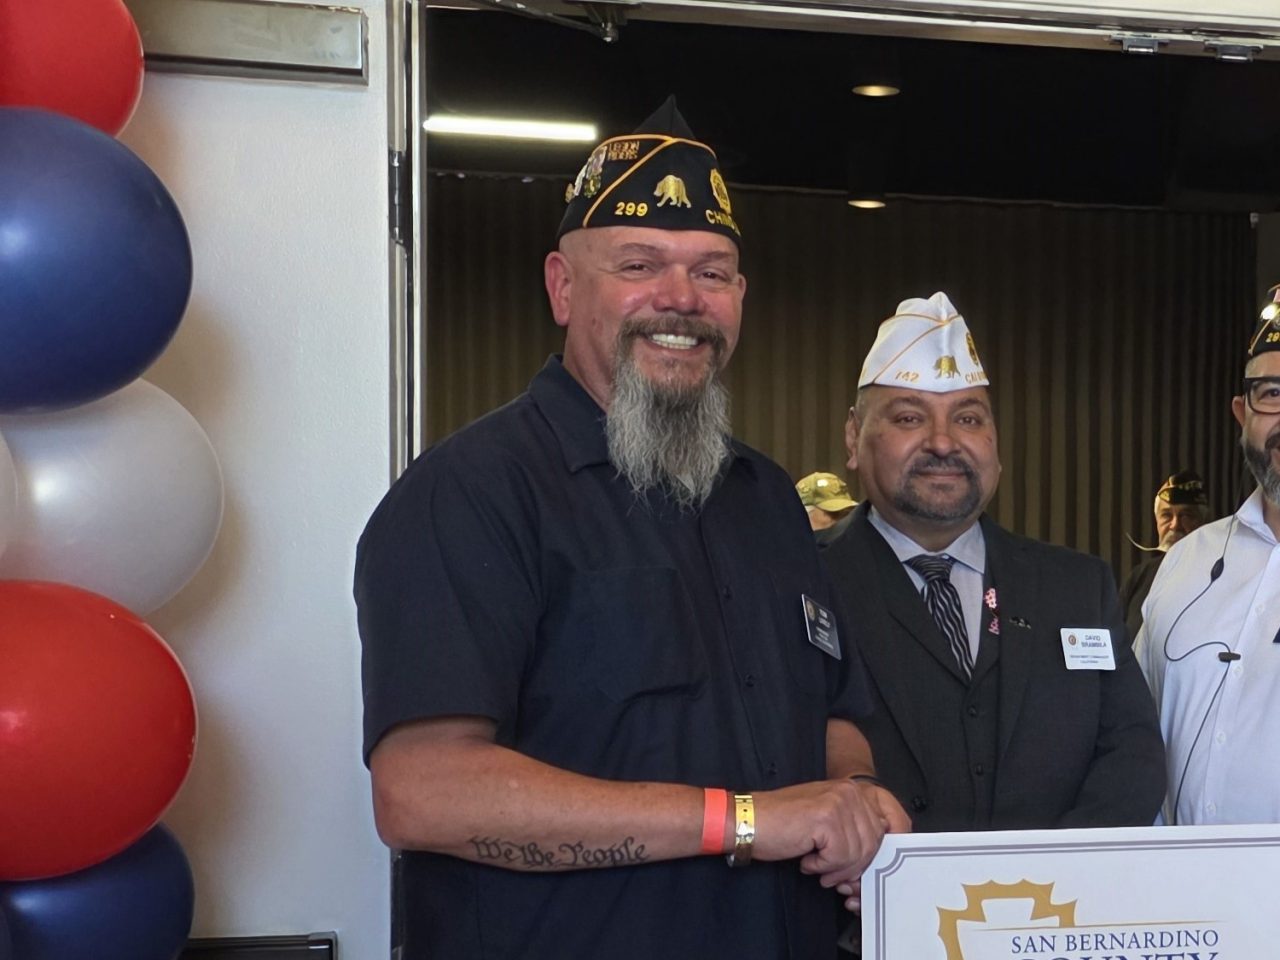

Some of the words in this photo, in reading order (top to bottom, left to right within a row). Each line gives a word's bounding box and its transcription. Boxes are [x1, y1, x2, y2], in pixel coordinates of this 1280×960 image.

[614, 202, 648, 217] 299
[466, 836, 520, 863] We
[558, 836, 650, 867] People
[1011, 935, 1056, 954] SAN
[1065, 930, 1219, 952] BERNARDINO
